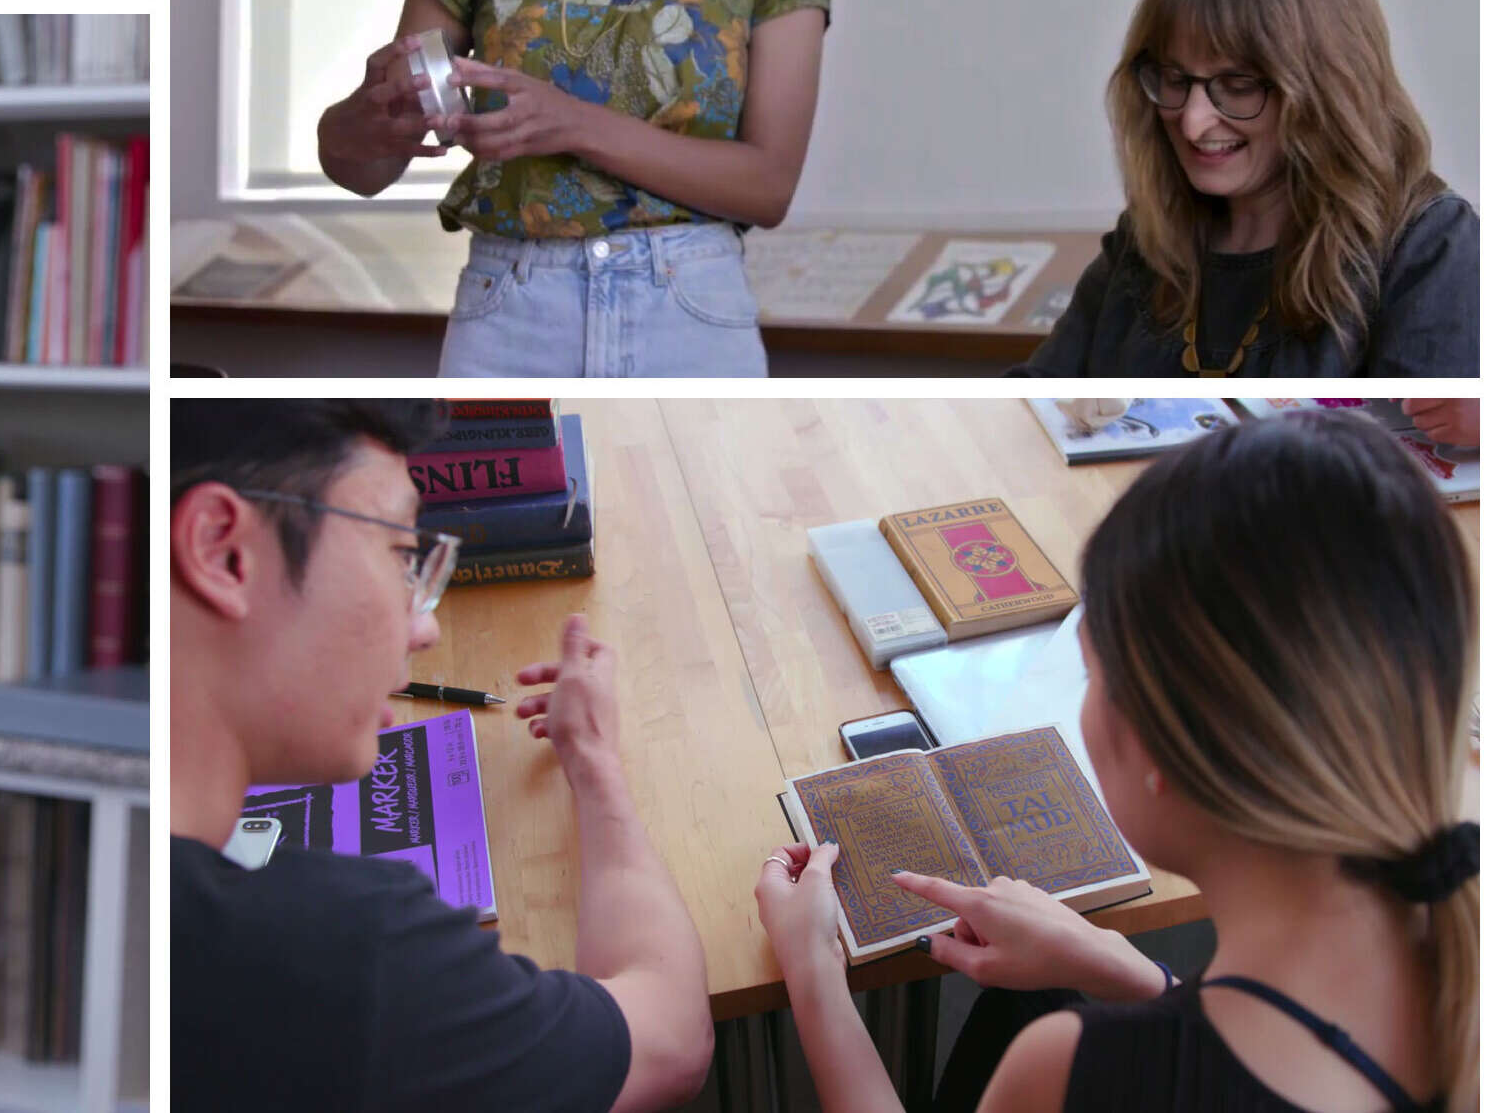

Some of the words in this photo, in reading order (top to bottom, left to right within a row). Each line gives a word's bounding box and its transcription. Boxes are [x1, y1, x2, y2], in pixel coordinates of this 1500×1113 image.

[901, 501, 1003, 529] LAZARRE
[980, 593, 1056, 613] CATHERWOOD
[371, 748, 402, 832] MARKER
[1000, 791, 1061, 818] TAL
[408, 815, 421, 843] MARKER
[1005, 808, 1071, 839] MUD
